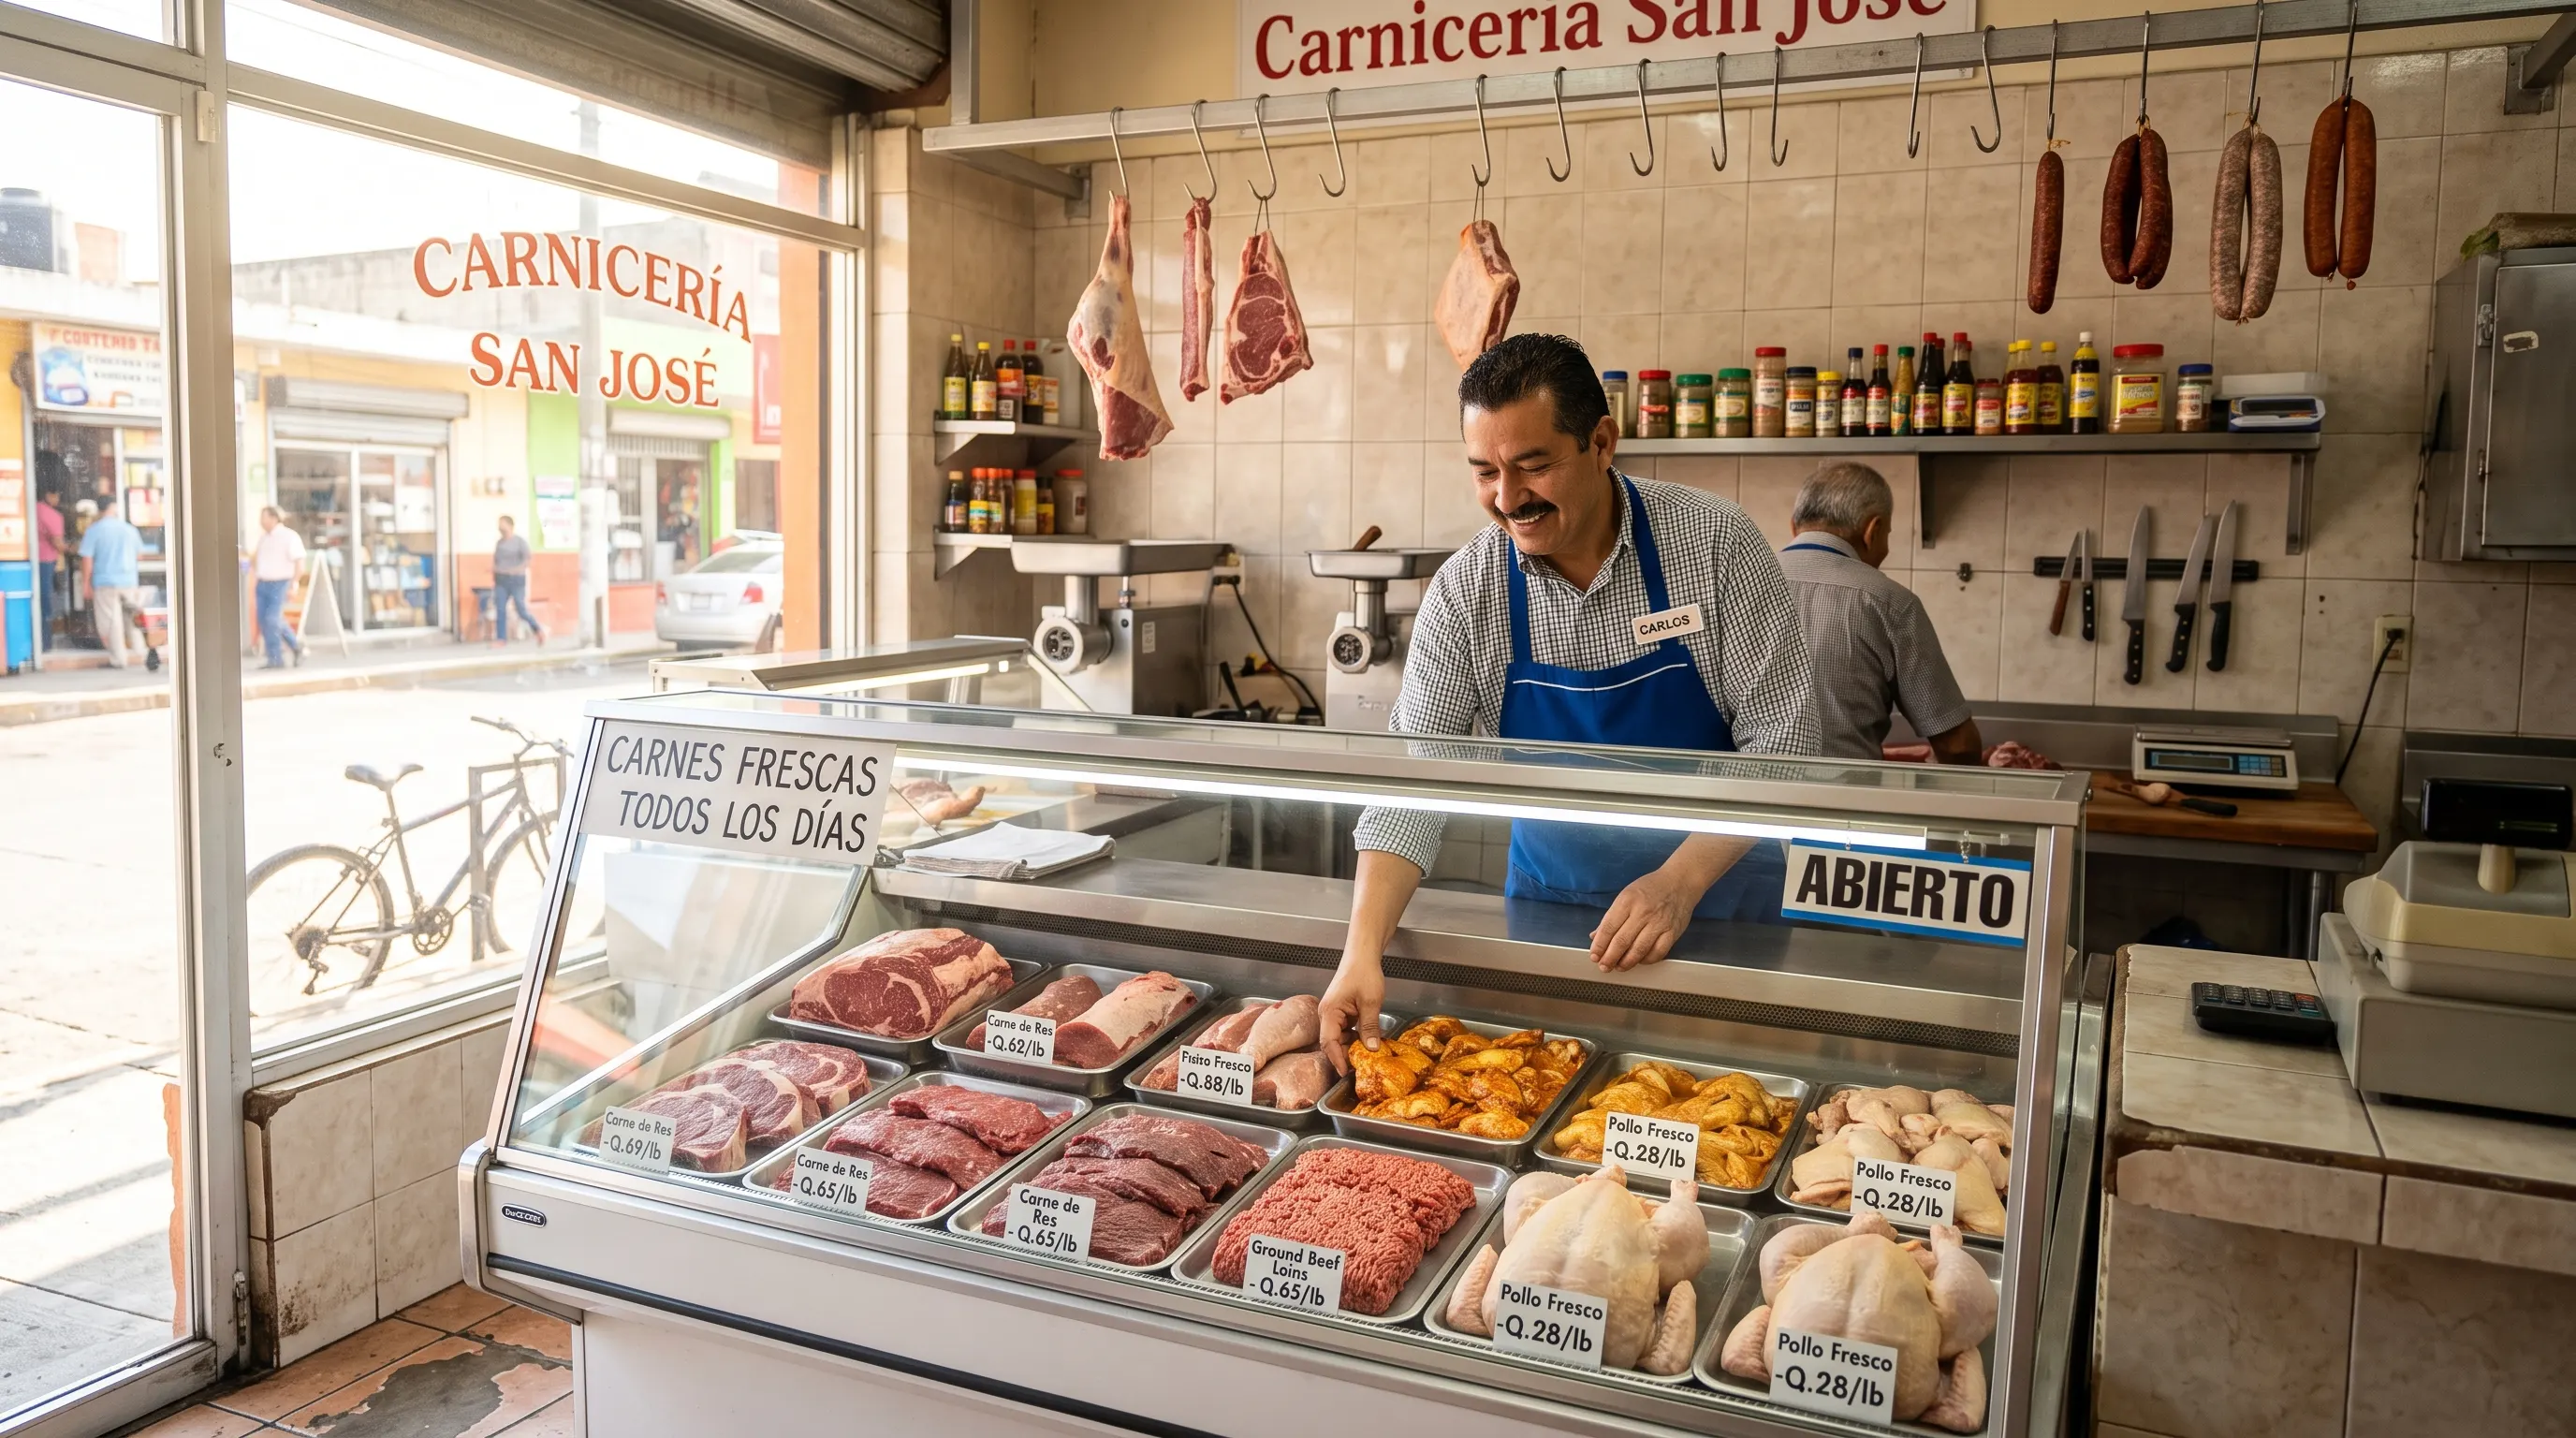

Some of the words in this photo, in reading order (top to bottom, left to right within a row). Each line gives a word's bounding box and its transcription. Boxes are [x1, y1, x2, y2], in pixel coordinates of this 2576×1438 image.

[1627, 0, 1762, 44] San
[413, 231, 752, 344] CARNICERÍA
[470, 331, 580, 394] SAN
[599, 347, 719, 407] JOSÉ
[1639, 614, 1690, 635] CARLOS
[607, 735, 725, 783] CARNES
[736, 746, 878, 797] FRESCAS
[619, 790, 712, 835] TODOS
[722, 800, 780, 843] LOS
[791, 800, 868, 853] DÍAS
[1794, 853, 2015, 929] ABIERTO
[988, 1014, 1017, 1030] Carne
[1019, 1020, 1032, 1032] de
[1034, 1021, 1053, 1036] Res
[1214, 1055, 1251, 1073] Fresco
[606, 1111, 635, 1129] Carne
[638, 1118, 651, 1132] de
[653, 1121, 672, 1137] Res
[1608, 1116, 1643, 1135] Pollo
[1647, 1122, 1694, 1143] Fresco
[797, 1153, 829, 1172] Carne
[832, 1161, 846, 1176] de
[848, 1164, 869, 1181] Res
[1856, 1161, 1895, 1181] Pollo
[1900, 1168, 1952, 1191] Fresco
[1019, 1188, 1059, 1210] Carne
[1062, 1197, 1080, 1214] de
[1032, 1208, 1058, 1227] Res
[1251, 1240, 1304, 1263] Ground
[1308, 1250, 1341, 1270] Beef
[1272, 1259, 1309, 1282] Loins
[1500, 1283, 1542, 1308] Pollo
[1547, 1292, 1603, 1321] Fresco
[1778, 1332, 1823, 1358] Pollo
[1831, 1342, 1893, 1372] Fresco
